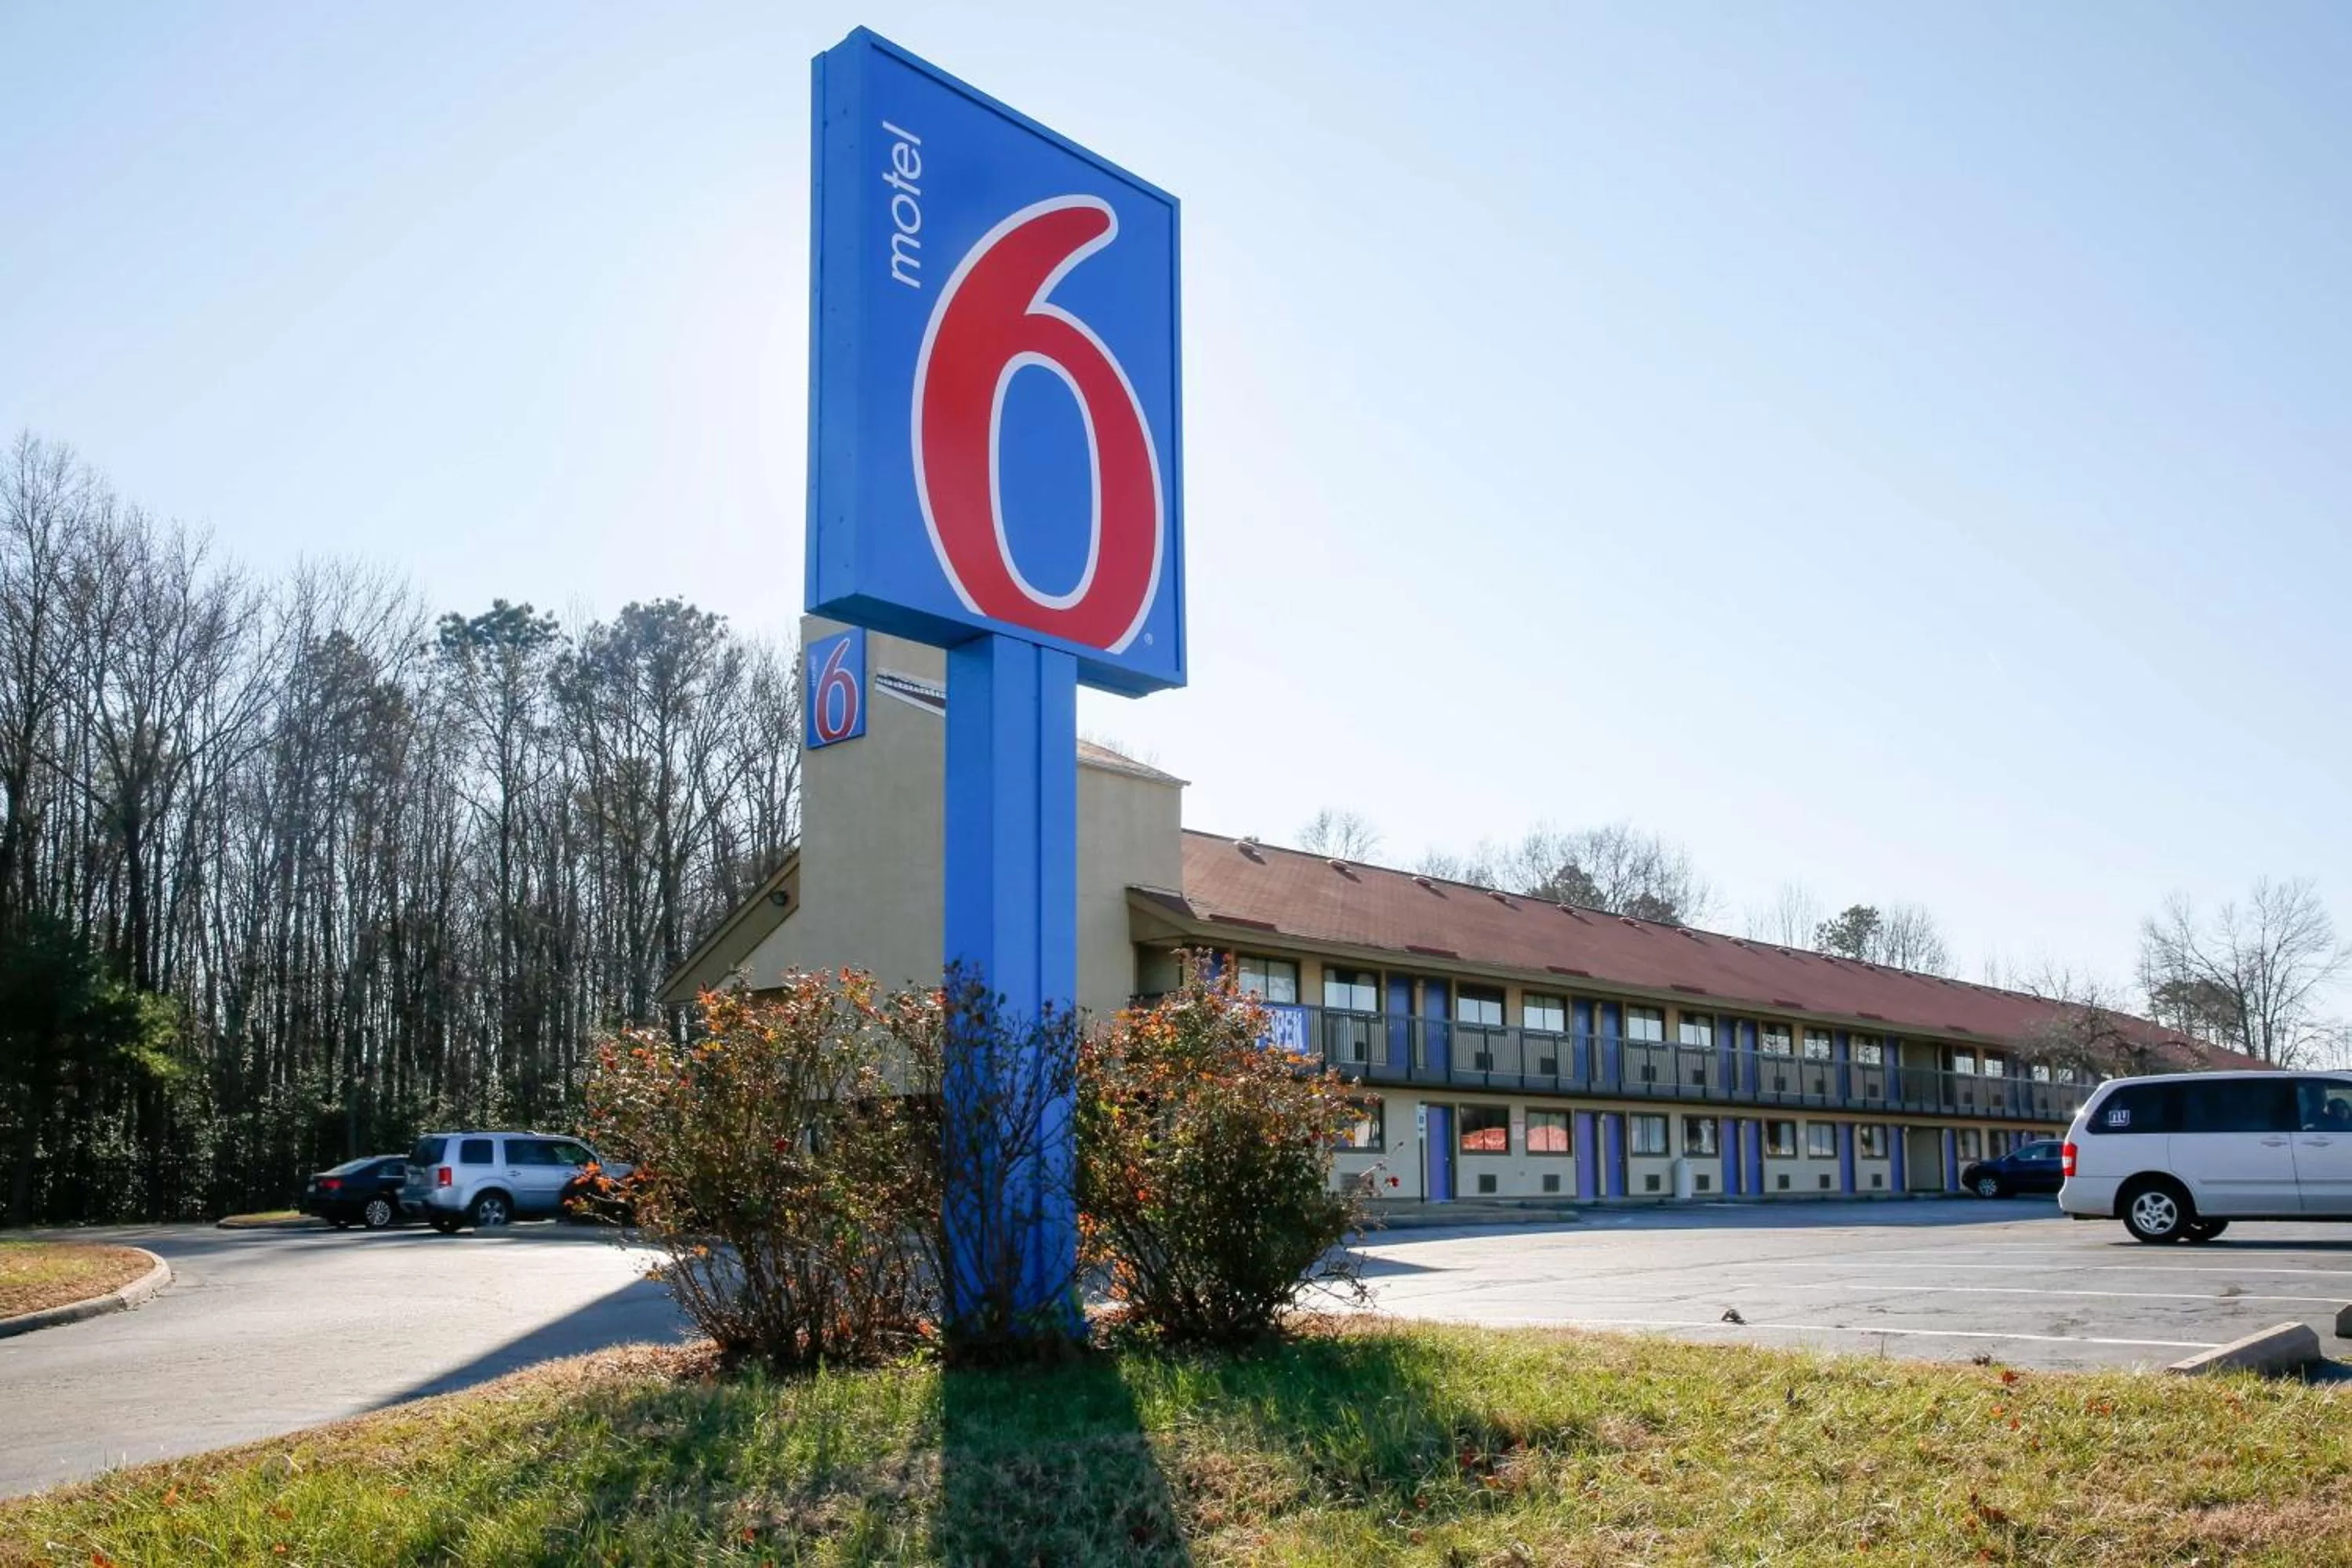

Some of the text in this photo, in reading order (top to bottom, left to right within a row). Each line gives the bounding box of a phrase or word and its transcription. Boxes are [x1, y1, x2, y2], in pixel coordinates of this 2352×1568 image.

[882, 120, 921, 289] motel
[911, 194, 1165, 655] 6
[815, 637, 858, 743] 6
